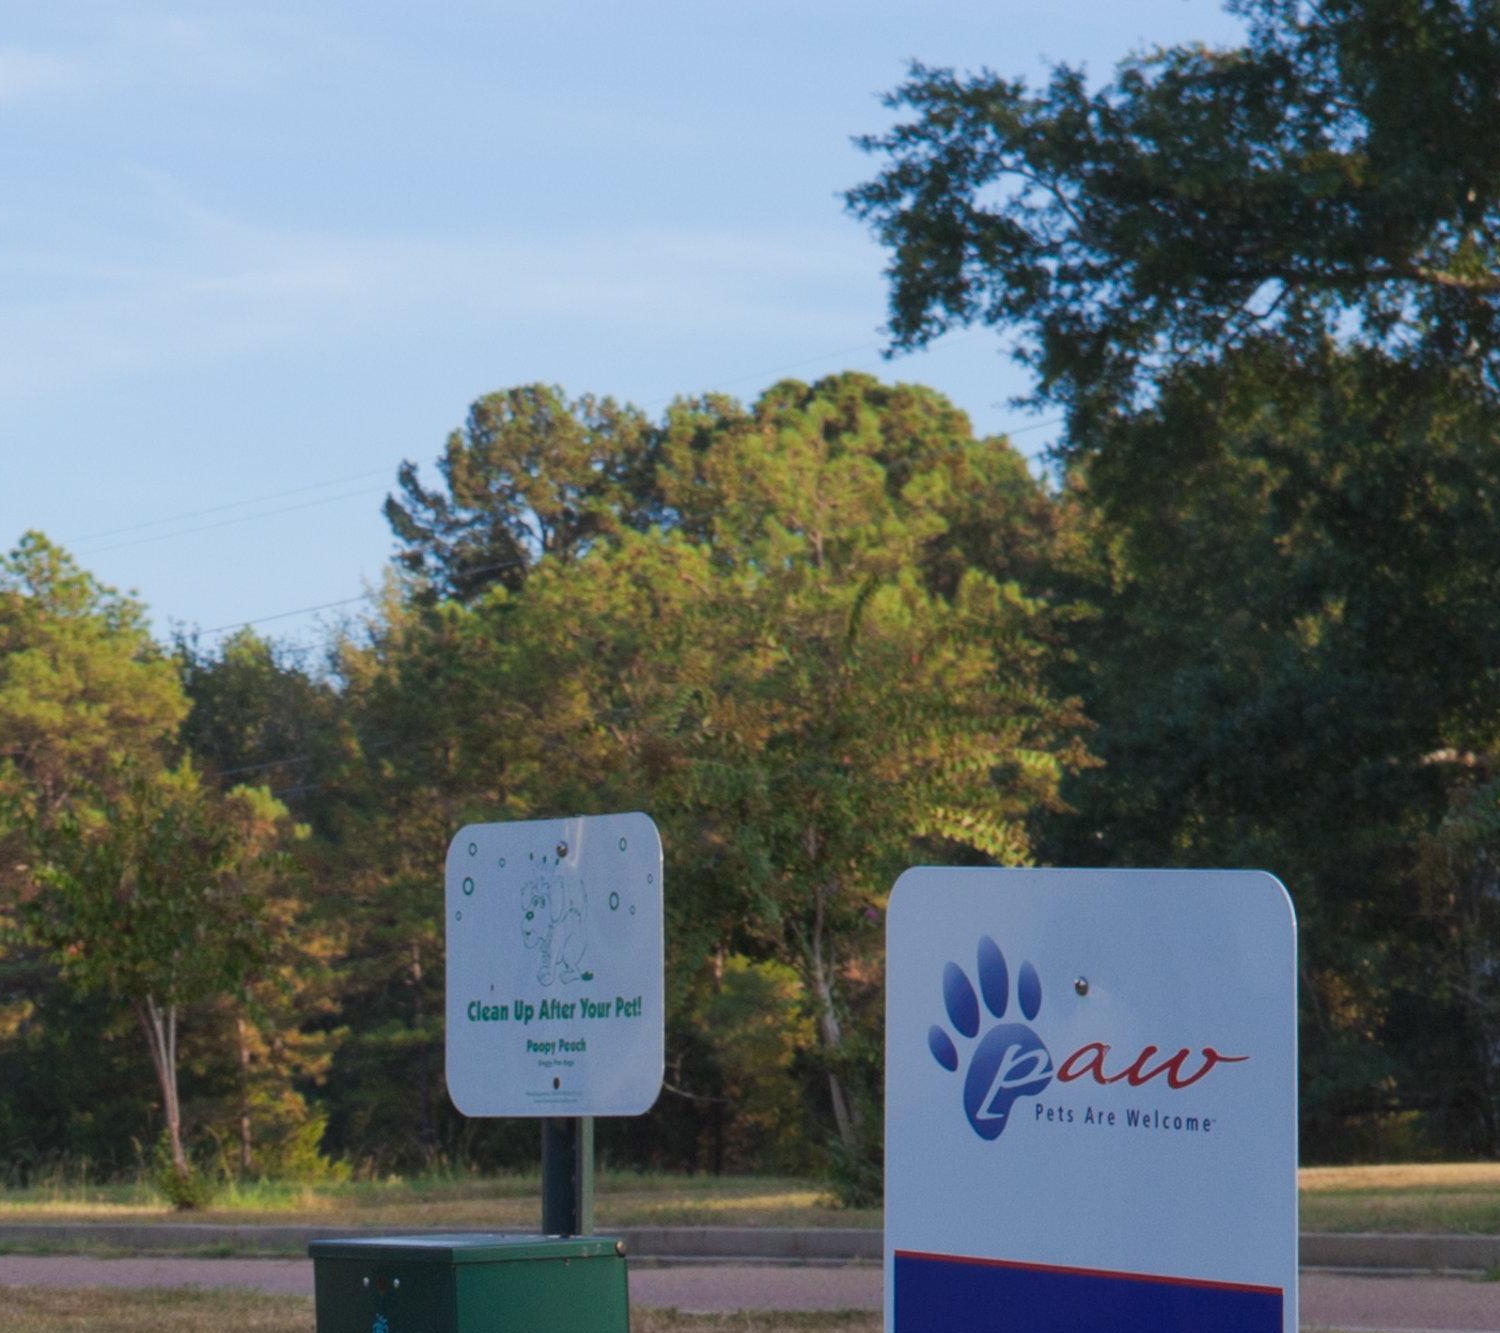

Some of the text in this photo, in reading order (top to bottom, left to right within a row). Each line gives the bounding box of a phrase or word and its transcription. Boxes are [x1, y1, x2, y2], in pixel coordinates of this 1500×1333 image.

[467, 996, 642, 1026] Clean Up After Your Pet!
[526, 1038, 556, 1056] Poopy
[1035, 1103, 1212, 1132] Pets Are Welcome
